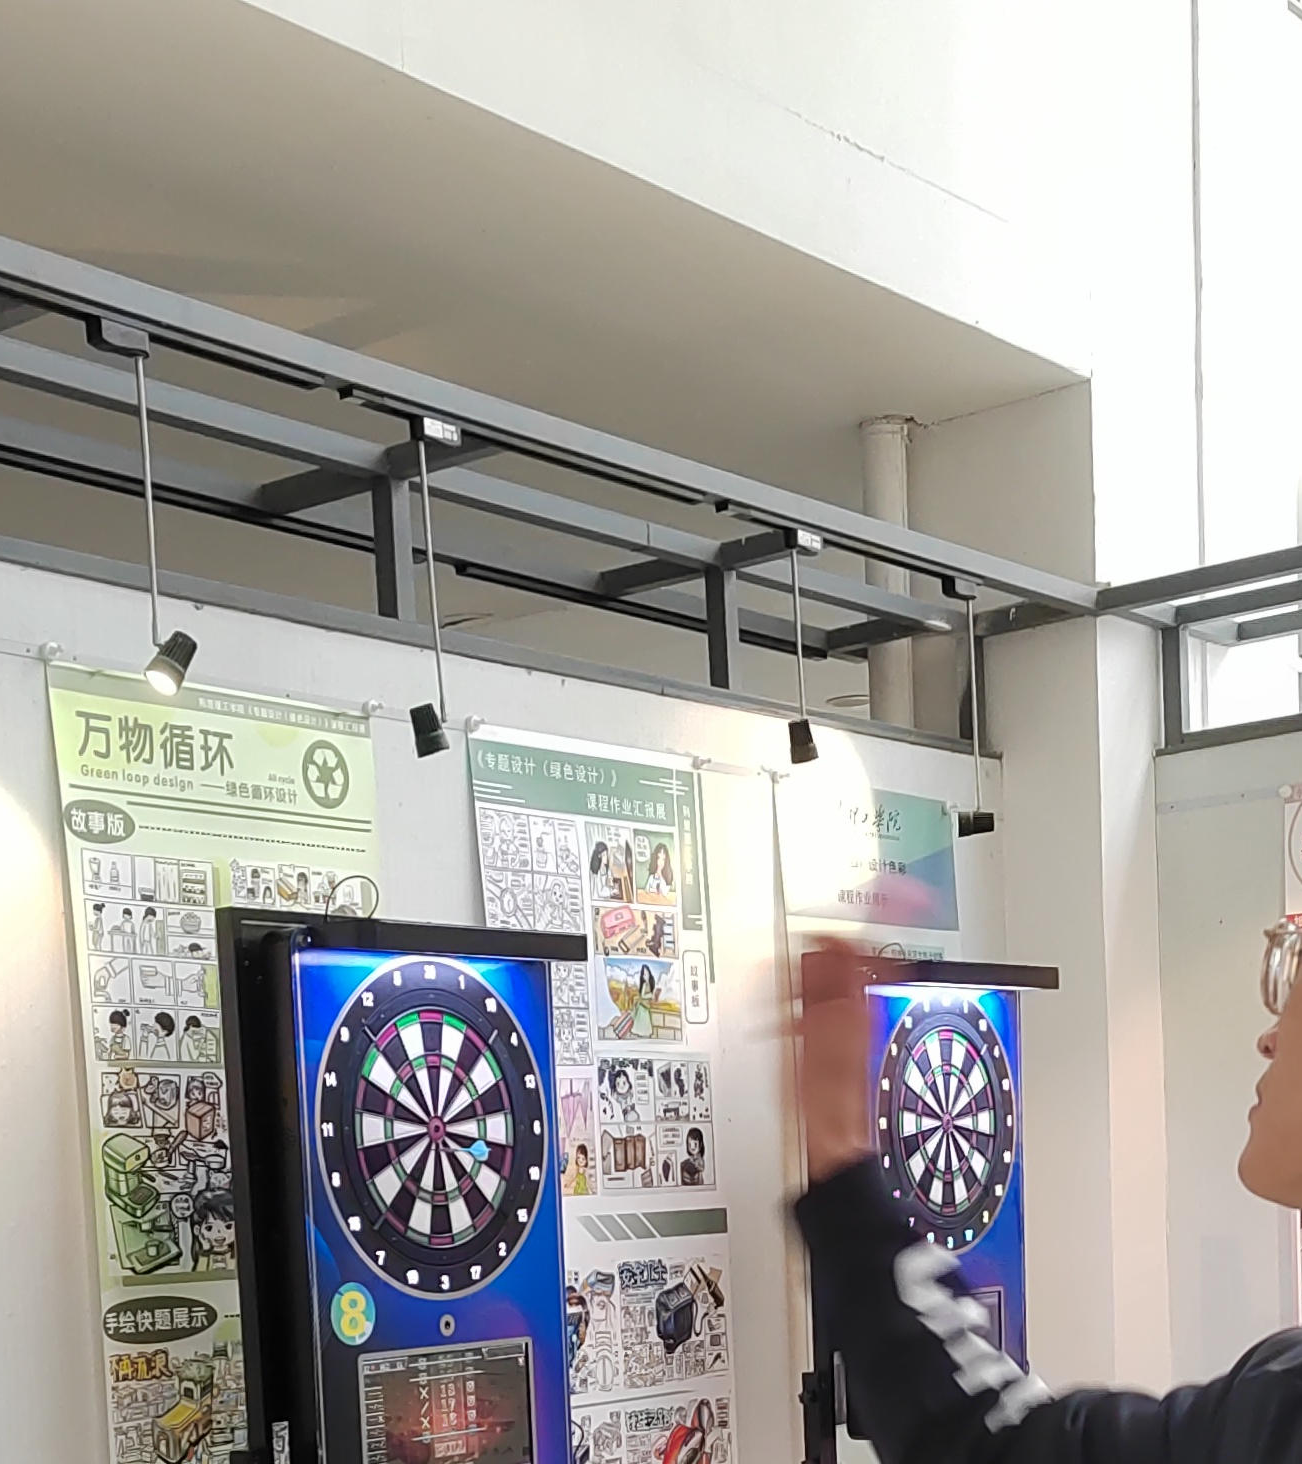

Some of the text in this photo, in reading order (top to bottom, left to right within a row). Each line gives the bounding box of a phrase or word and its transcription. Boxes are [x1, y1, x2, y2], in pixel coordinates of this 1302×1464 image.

[74, 709, 235, 777] 万物循环
[80, 763, 195, 792] Green loop design
[69, 807, 127, 838] 故事版
[458, 975, 465, 990] 1
[361, 992, 374, 1006] 12
[510, 1031, 518, 1046] 4
[324, 1072, 337, 1087] 14
[525, 1074, 536, 1089] 13
[321, 1122, 334, 1137] 11
[331, 1171, 341, 1187] 8
[529, 1166, 540, 1181] 10
[516, 1208, 528, 1223] 15
[498, 1242, 507, 1257] 2
[376, 1250, 386, 1266] 7
[440, 1275, 450, 1290] 3
[104, 1306, 210, 1333] 手绘快题展示
[339, 1291, 366, 1337] 8
